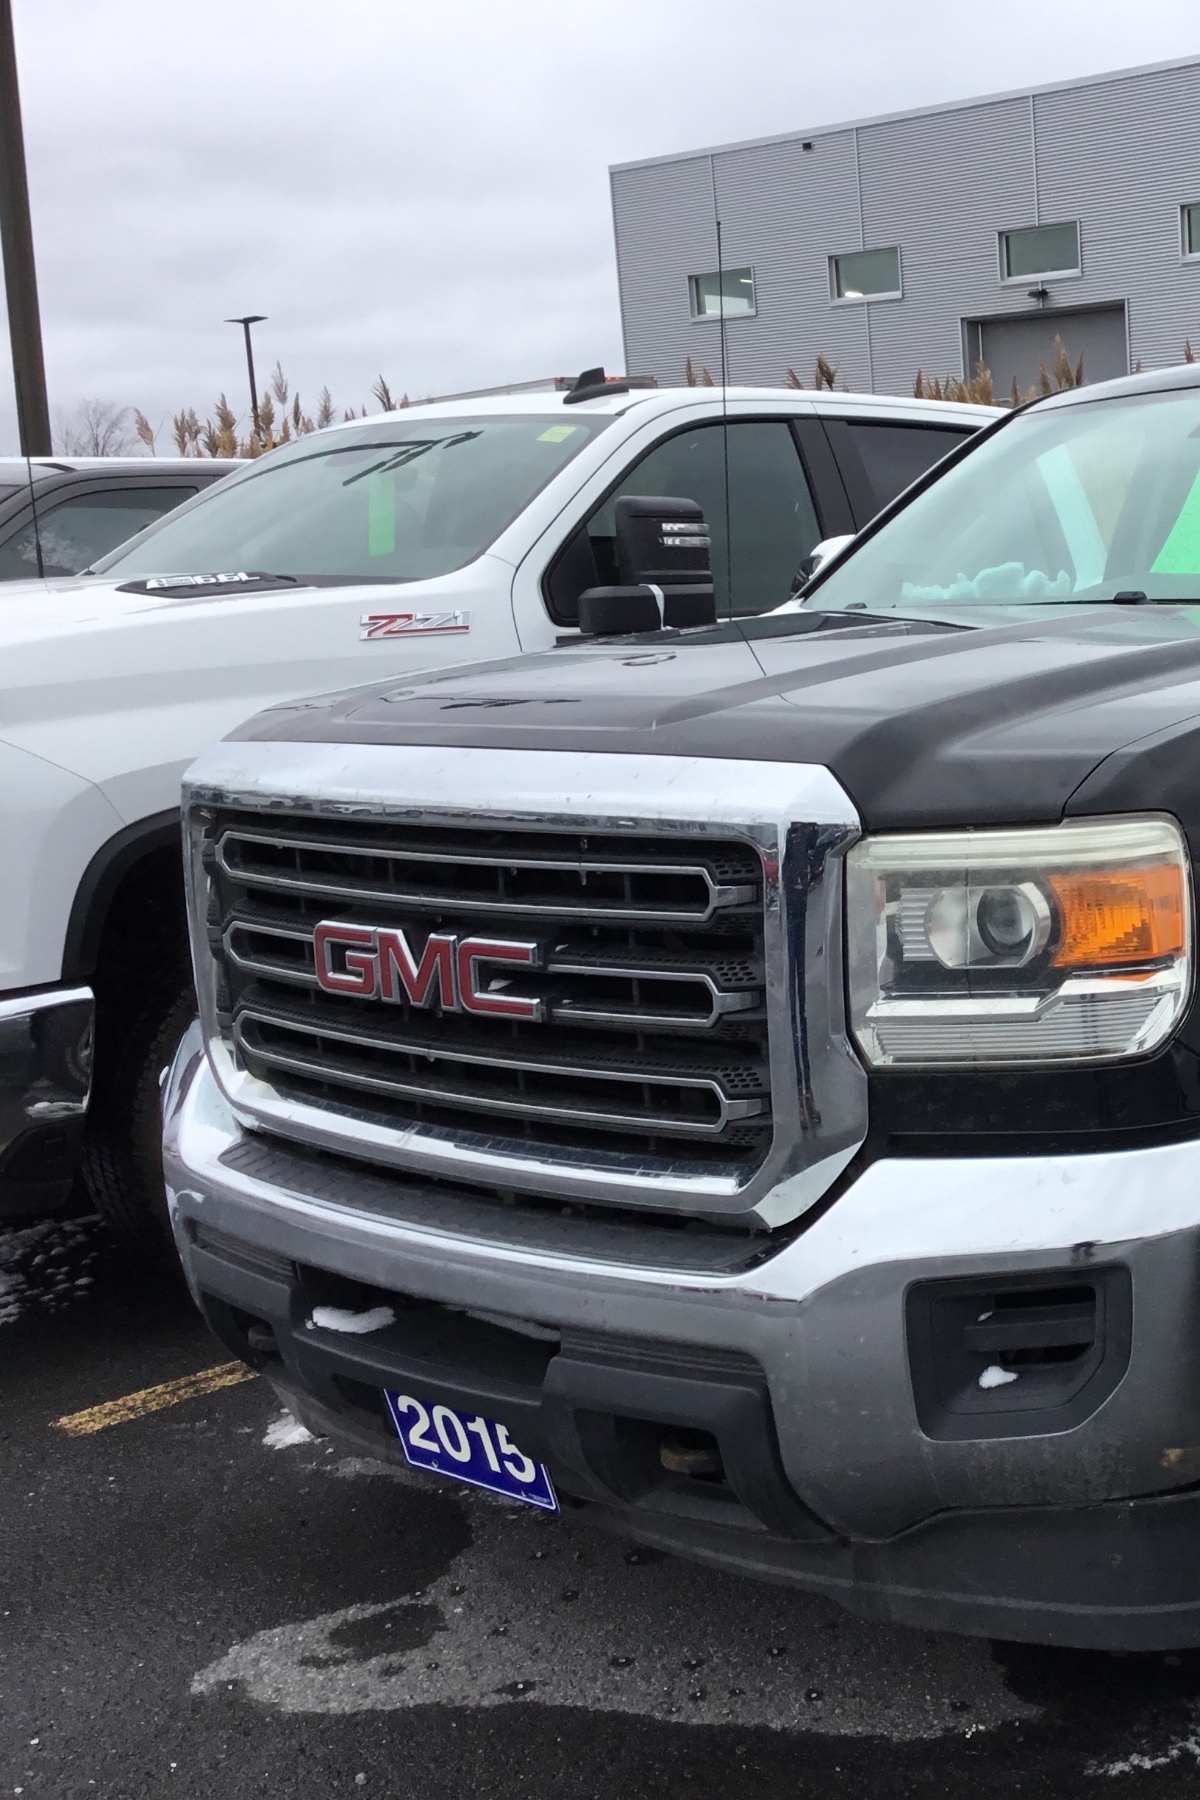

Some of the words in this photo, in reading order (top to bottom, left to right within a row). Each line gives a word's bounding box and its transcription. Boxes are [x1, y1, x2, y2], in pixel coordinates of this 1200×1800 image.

[359, 610, 472, 641] Z71
[313, 920, 543, 1023] GMC
[398, 1395, 536, 1483] 2015
